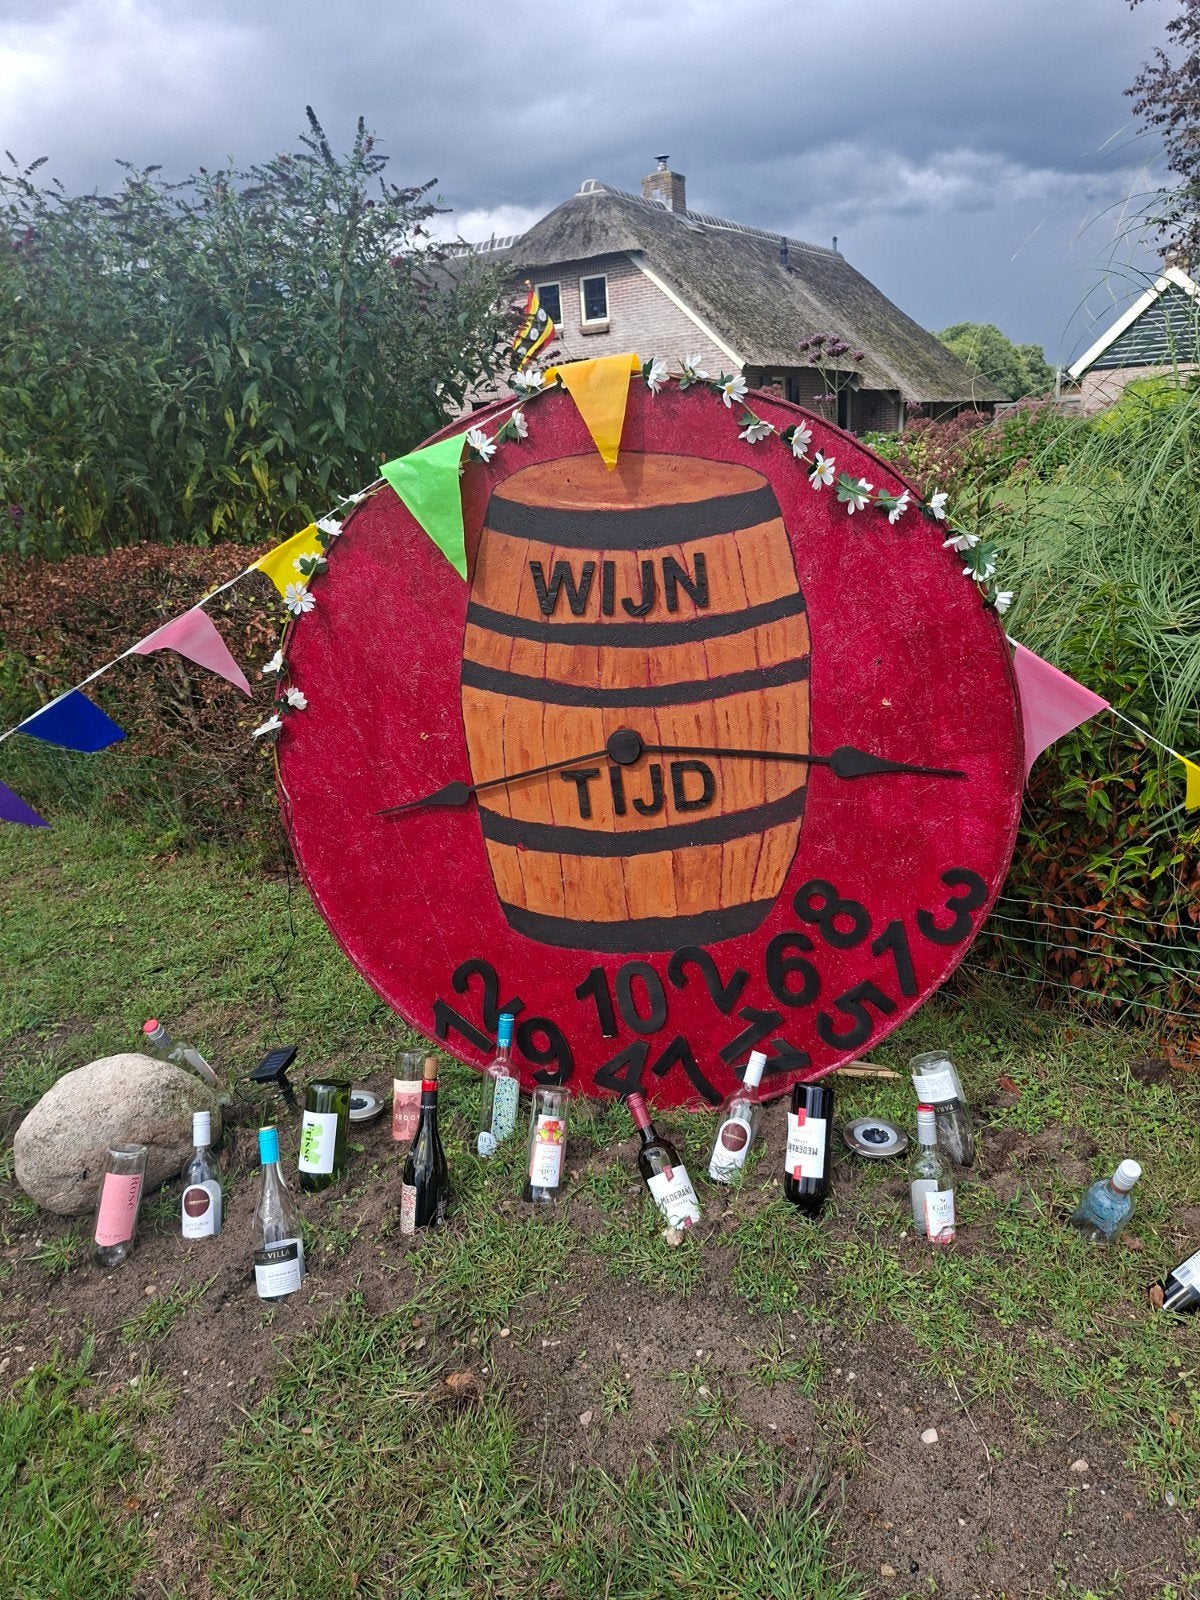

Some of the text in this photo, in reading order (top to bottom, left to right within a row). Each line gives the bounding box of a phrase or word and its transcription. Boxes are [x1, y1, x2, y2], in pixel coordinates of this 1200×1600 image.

[529, 552, 708, 617] WIJN
[560, 759, 716, 819] TIJD
[794, 879, 871, 949] 8
[917, 867, 988, 945] 3
[667, 945, 749, 1016] 2
[765, 932, 821, 1008] 6
[871, 919, 919, 997] 1
[432, 957, 525, 1054] 12
[575, 961, 668, 1037] 10
[815, 980, 898, 1051] 5
[516, 1016, 574, 1086] 9
[593, 1038, 650, 1098] 4
[651, 1034, 723, 1107] 7
[303, 1122, 315, 1162] Frisse
[660, 1184, 693, 1205] MEDERAÑA
[932, 1203, 952, 1211] Gallo
[267, 1249, 291, 1259] VILLA
